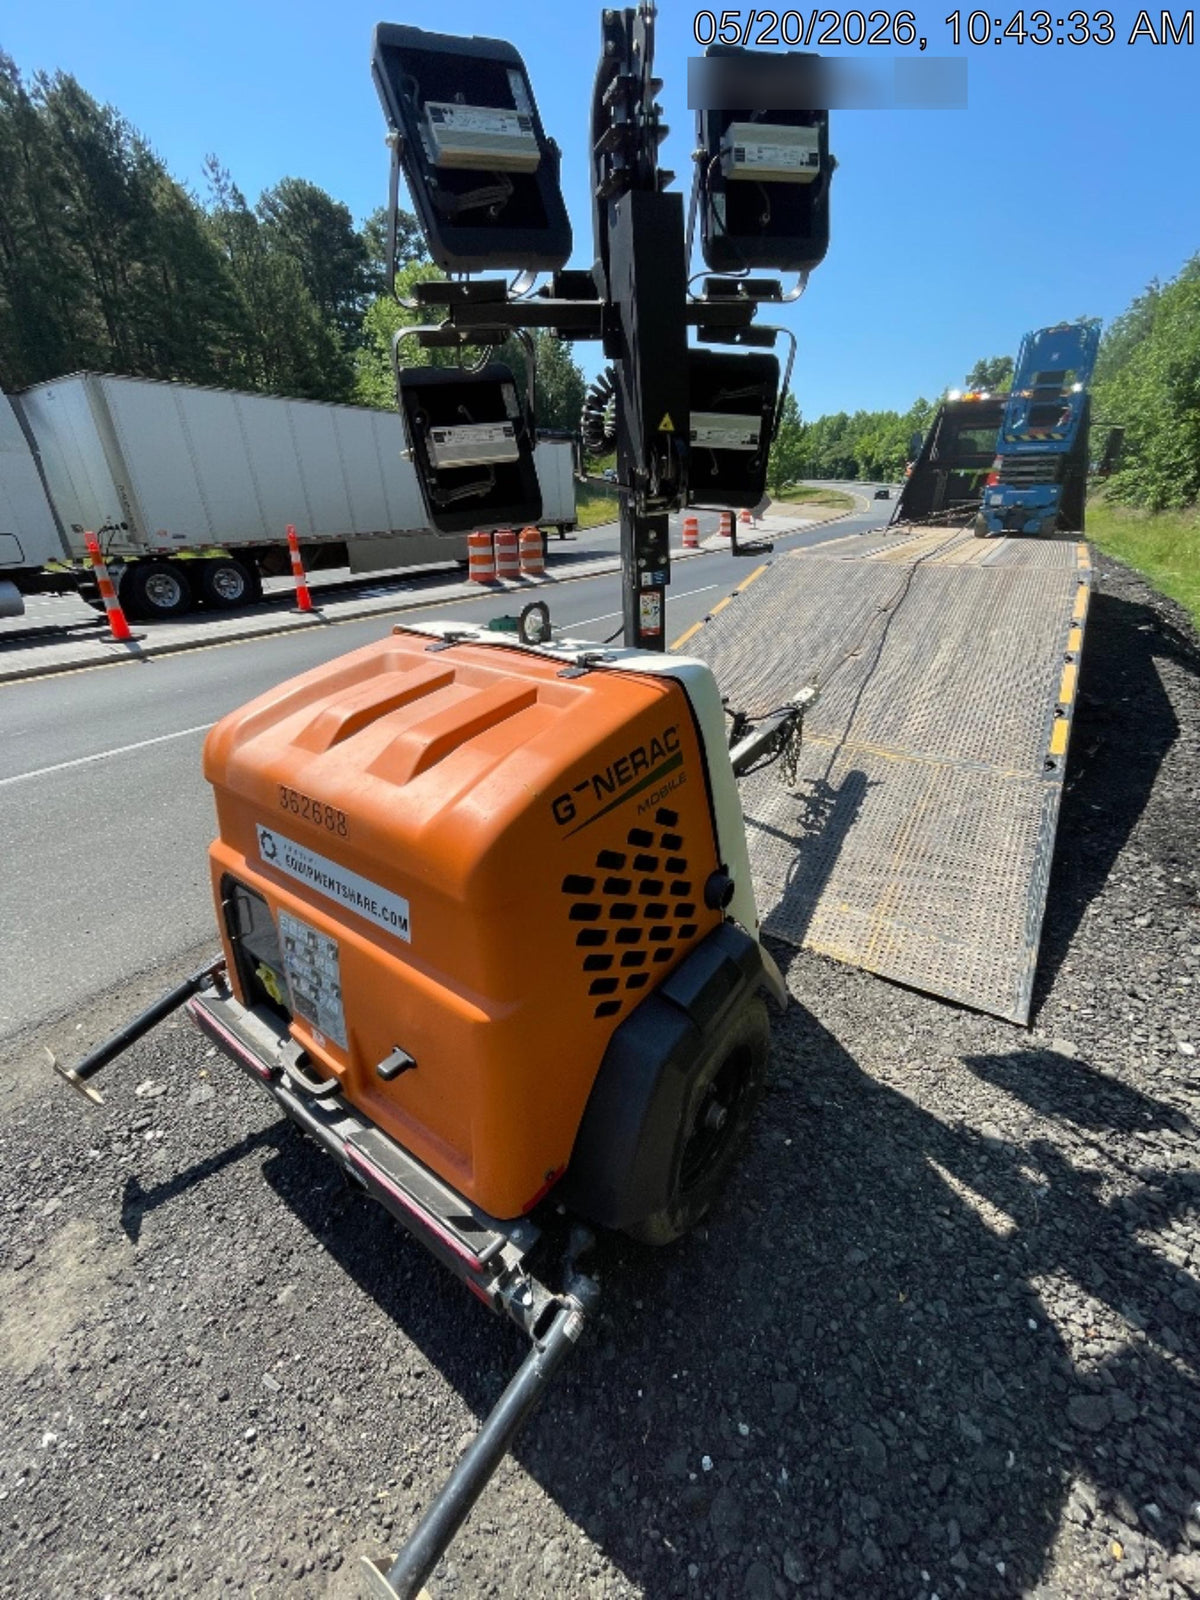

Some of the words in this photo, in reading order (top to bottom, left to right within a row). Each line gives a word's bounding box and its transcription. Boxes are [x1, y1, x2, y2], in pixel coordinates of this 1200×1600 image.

[280, 786, 347, 836] 362688
[637, 771, 687, 816] MOBILE
[285, 854, 409, 932] EQUIPMENTSHARE.COM
